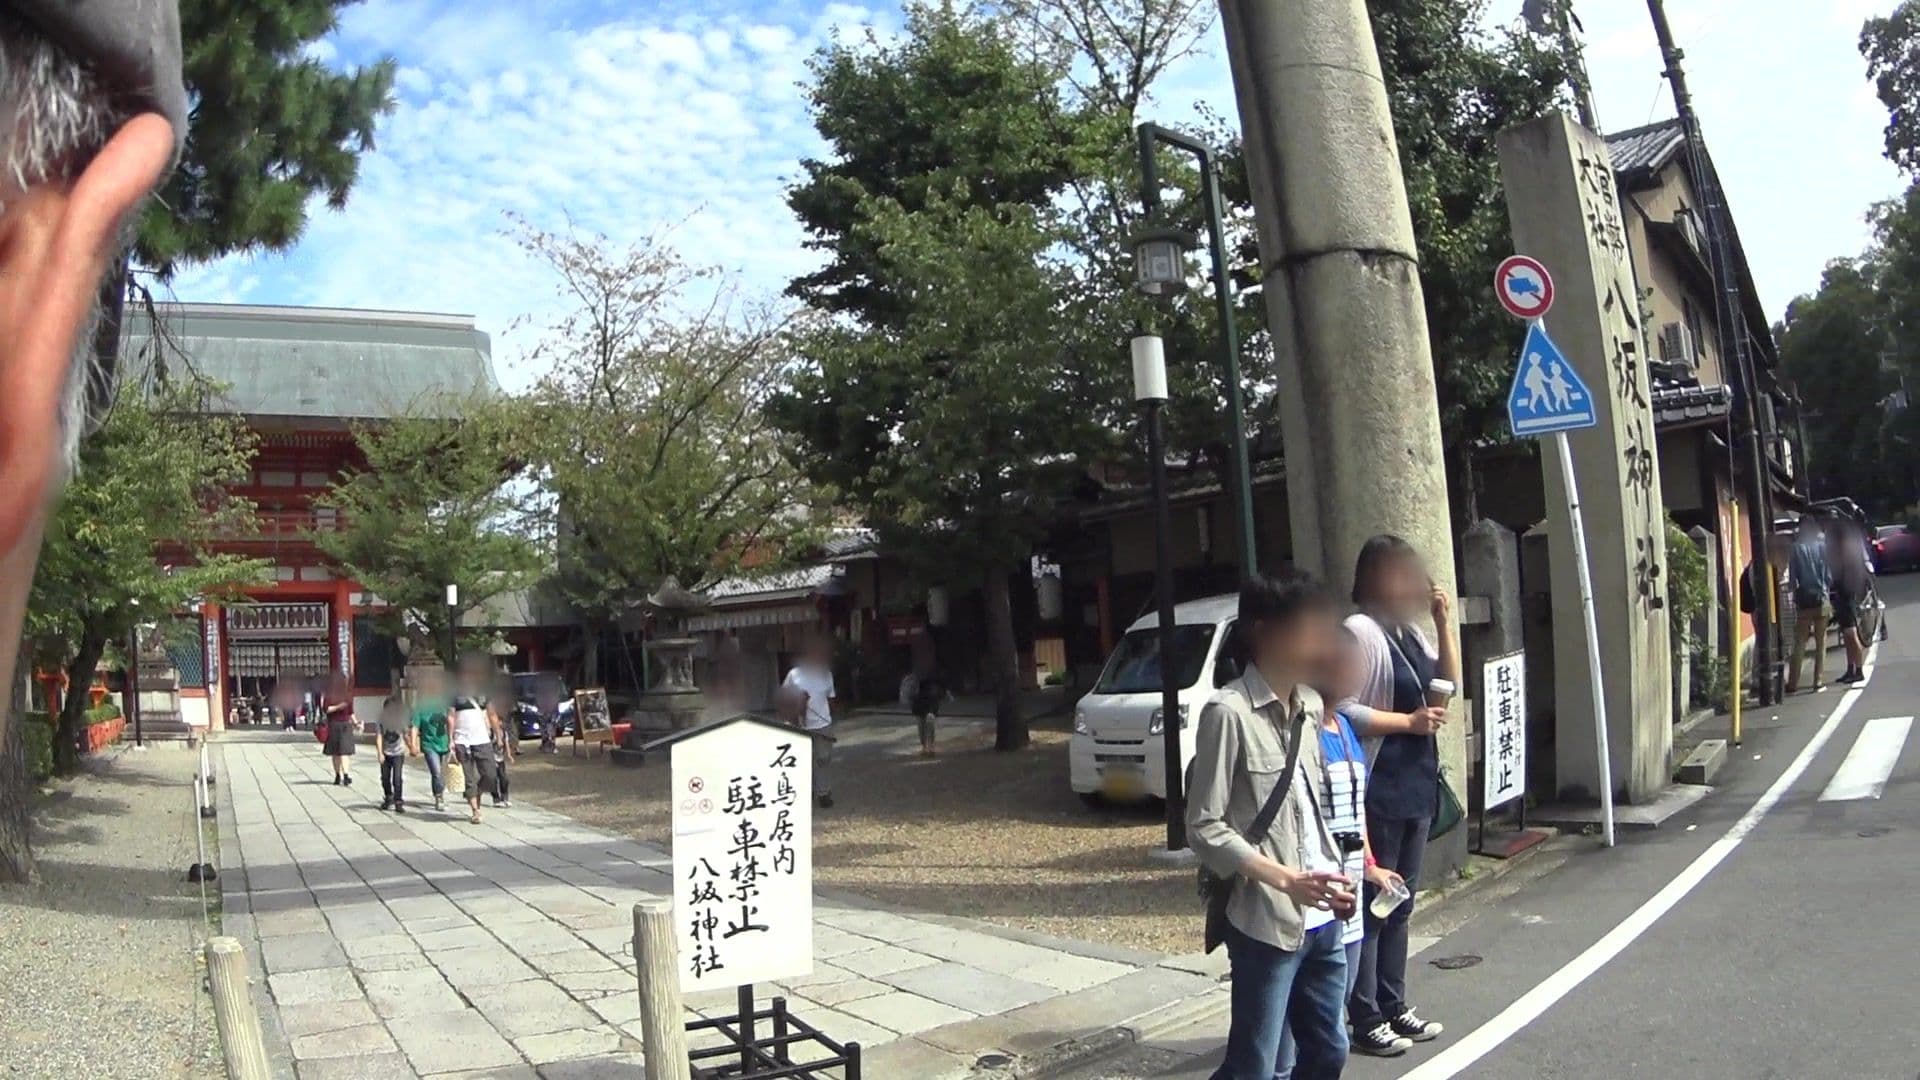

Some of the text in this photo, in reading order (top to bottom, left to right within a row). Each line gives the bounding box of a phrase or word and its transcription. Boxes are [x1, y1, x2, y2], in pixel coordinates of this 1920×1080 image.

[1603, 278, 1664, 620] 八坂神社
[1496, 665, 1513, 795] 駐車禁止
[722, 775, 770, 940] 駐車禁止
[769, 743, 797, 875] 石鳥居内
[688, 857, 725, 979] 八坂神社
